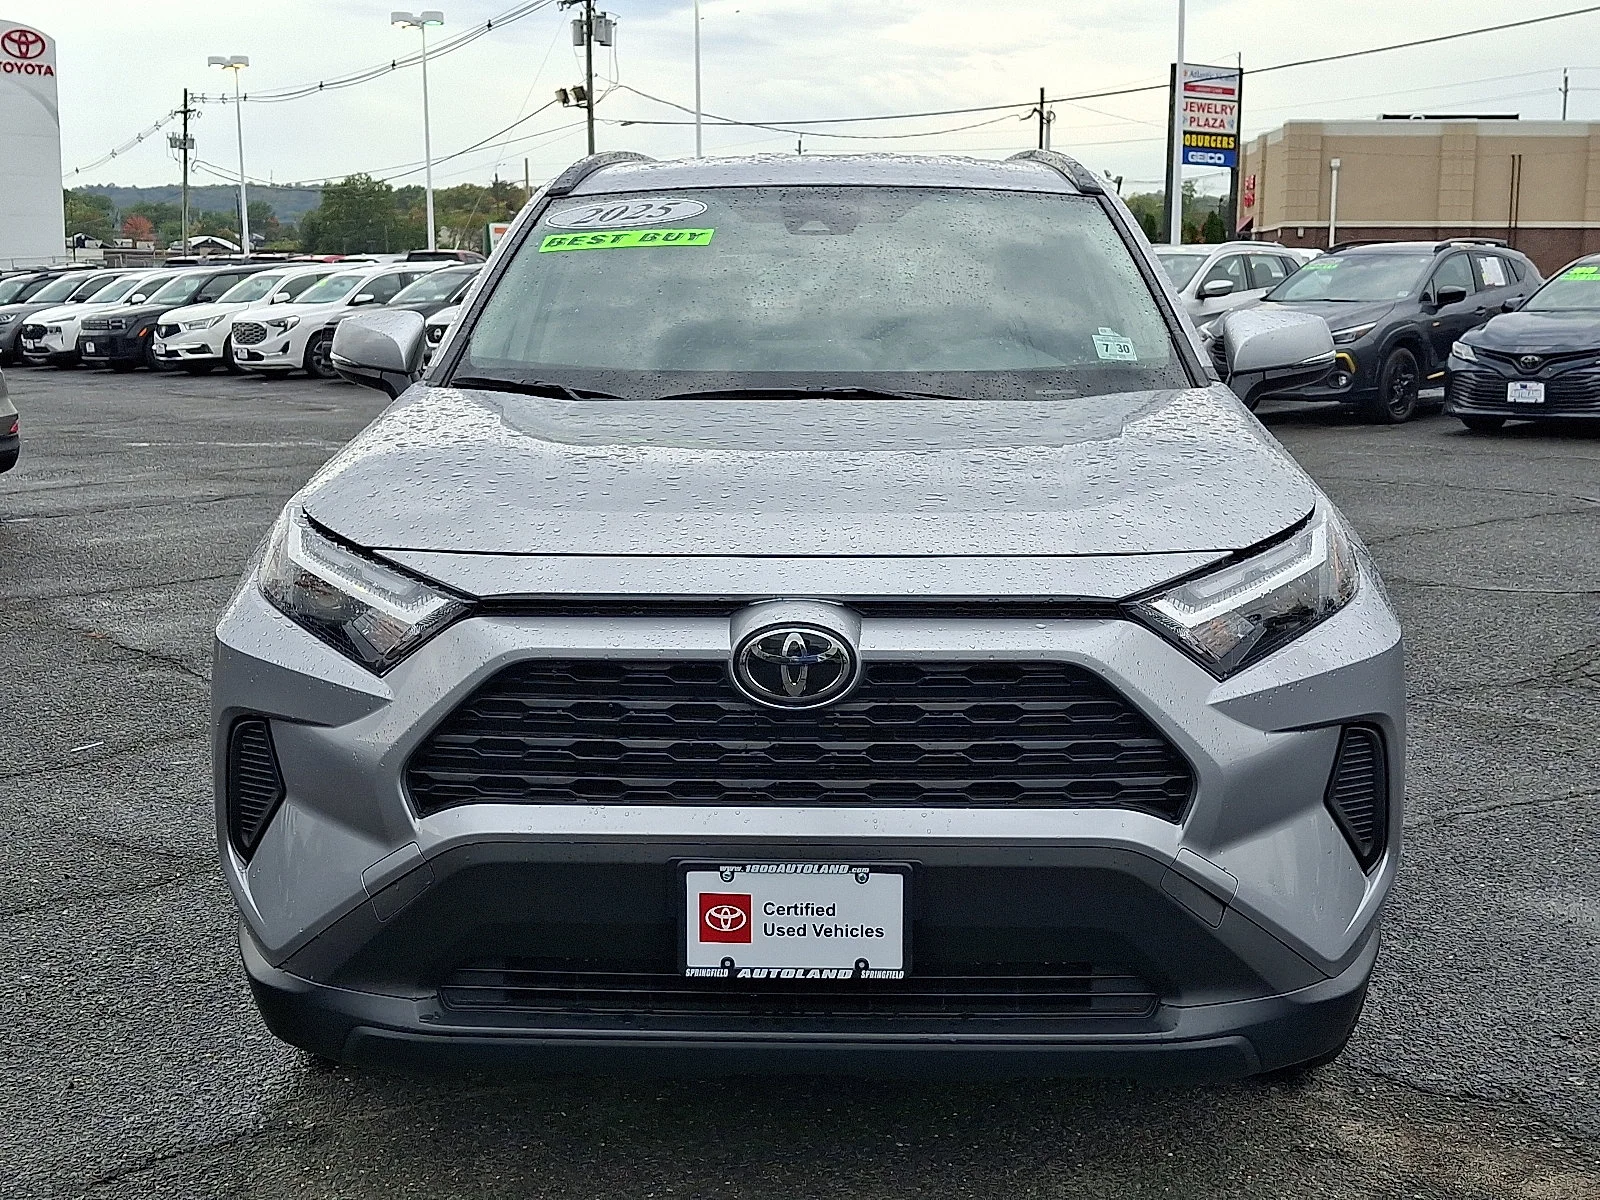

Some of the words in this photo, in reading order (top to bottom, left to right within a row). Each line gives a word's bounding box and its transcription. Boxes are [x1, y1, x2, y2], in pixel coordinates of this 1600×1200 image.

[0, 61, 54, 76] OYOTA
[1183, 101, 1235, 115] JEWELRY
[1189, 116, 1226, 129] PLAZA
[1182, 134, 1234, 148] OBURGERS
[1188, 151, 1225, 164] GEICO
[570, 202, 681, 225] 2025
[544, 233, 631, 248] BEST
[638, 232, 708, 243] BUY
[1102, 343, 1109, 353] 7
[1116, 343, 1130, 354] 30
[763, 902, 836, 917] Certified
[763, 923, 807, 937] Used
[812, 924, 885, 938] Vehicles
[685, 968, 729, 978] SPRINGFIELD
[736, 968, 853, 979] AUTOLAND
[860, 970, 905, 980] SPRINGFIELD
